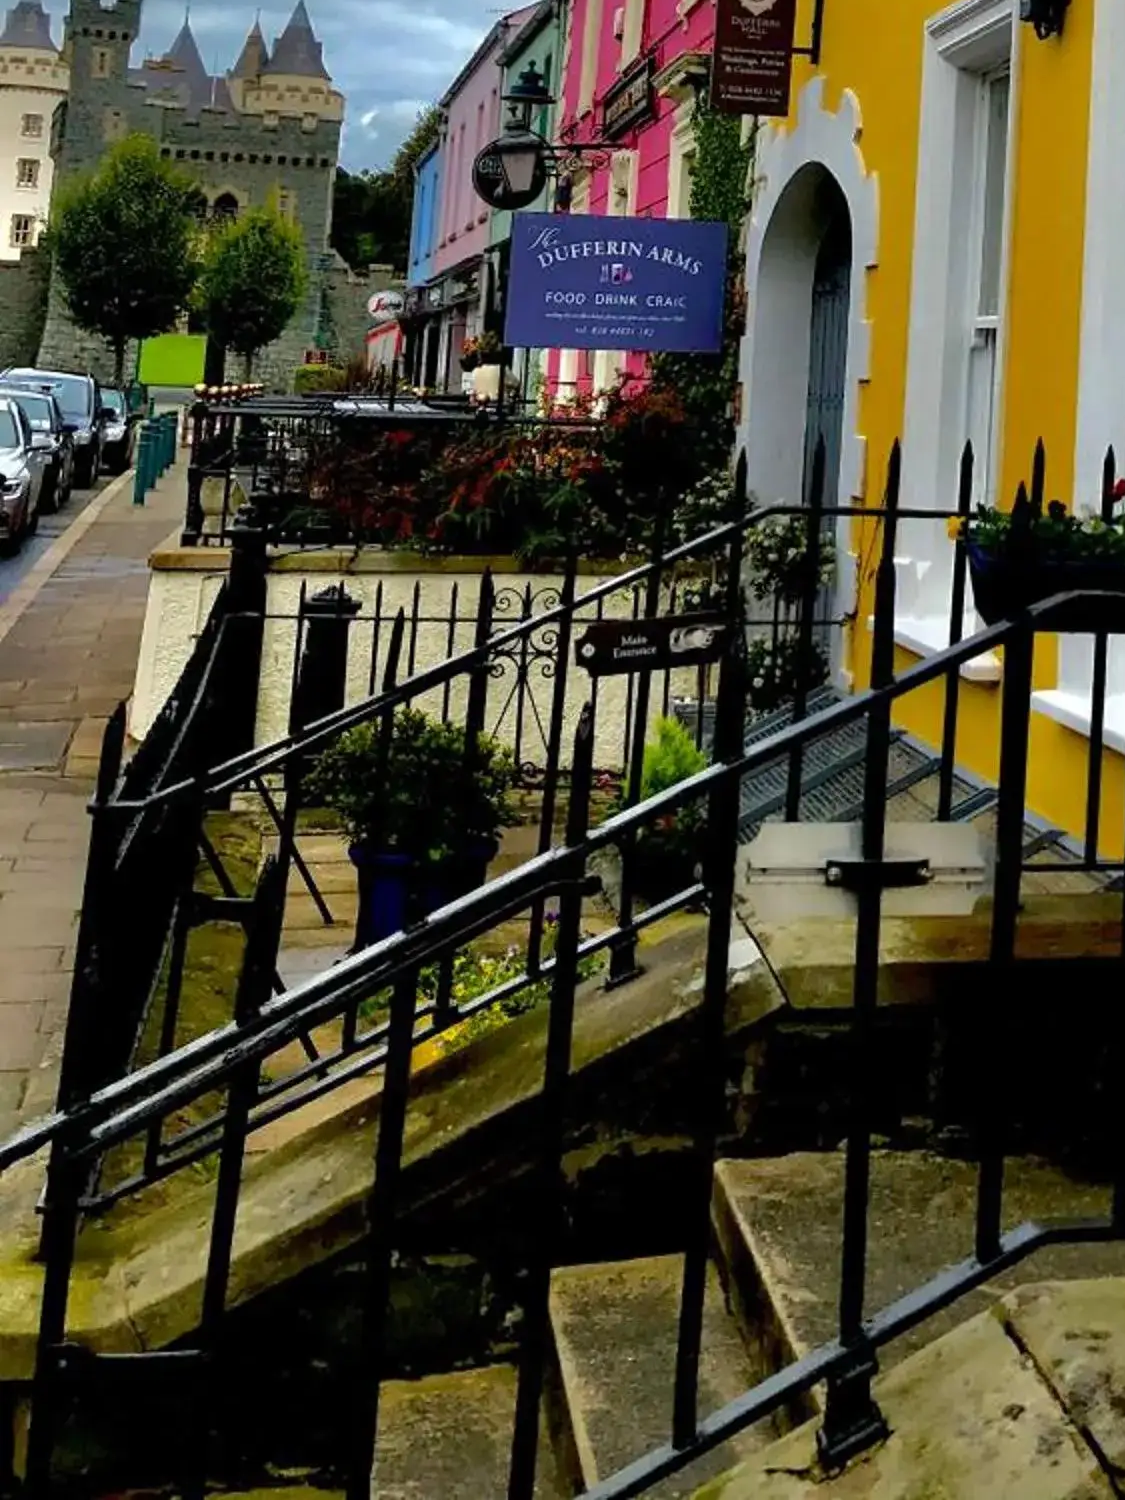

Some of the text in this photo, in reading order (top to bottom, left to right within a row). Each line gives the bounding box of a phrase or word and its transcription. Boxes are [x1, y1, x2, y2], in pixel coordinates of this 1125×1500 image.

[537, 240, 703, 275] DUFFERIN ARMS
[545, 291, 686, 309] FOOD DRINK CRAIC
